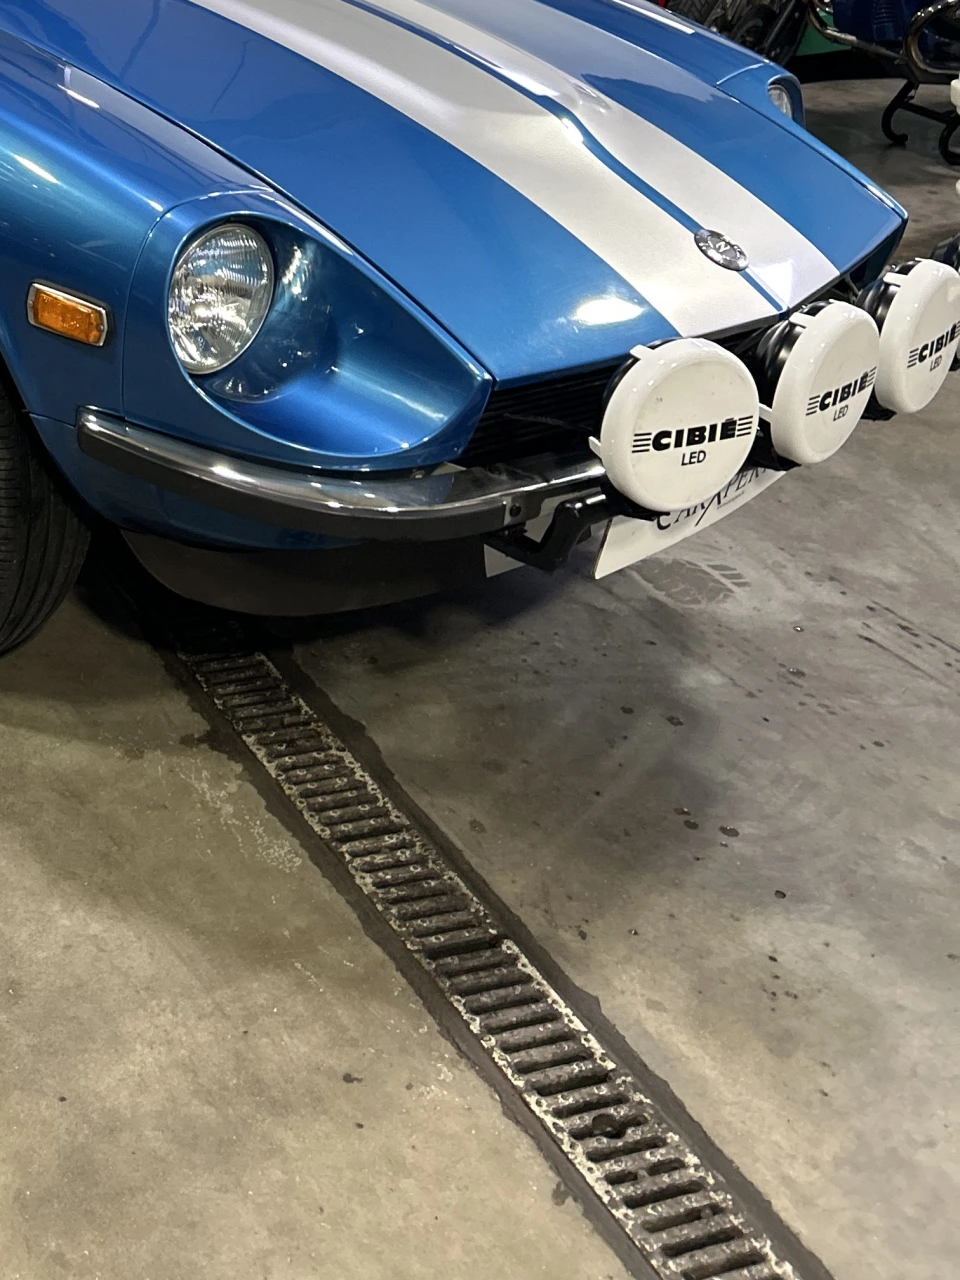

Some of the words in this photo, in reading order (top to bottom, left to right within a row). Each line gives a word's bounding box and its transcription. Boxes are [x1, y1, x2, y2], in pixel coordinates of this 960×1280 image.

[929, 355, 943, 372] LED
[818, 371, 869, 412] CIBIÉ
[832, 404, 849, 422] LED
[651, 417, 738, 452] CIBIÉ
[681, 450, 707, 466] LED
